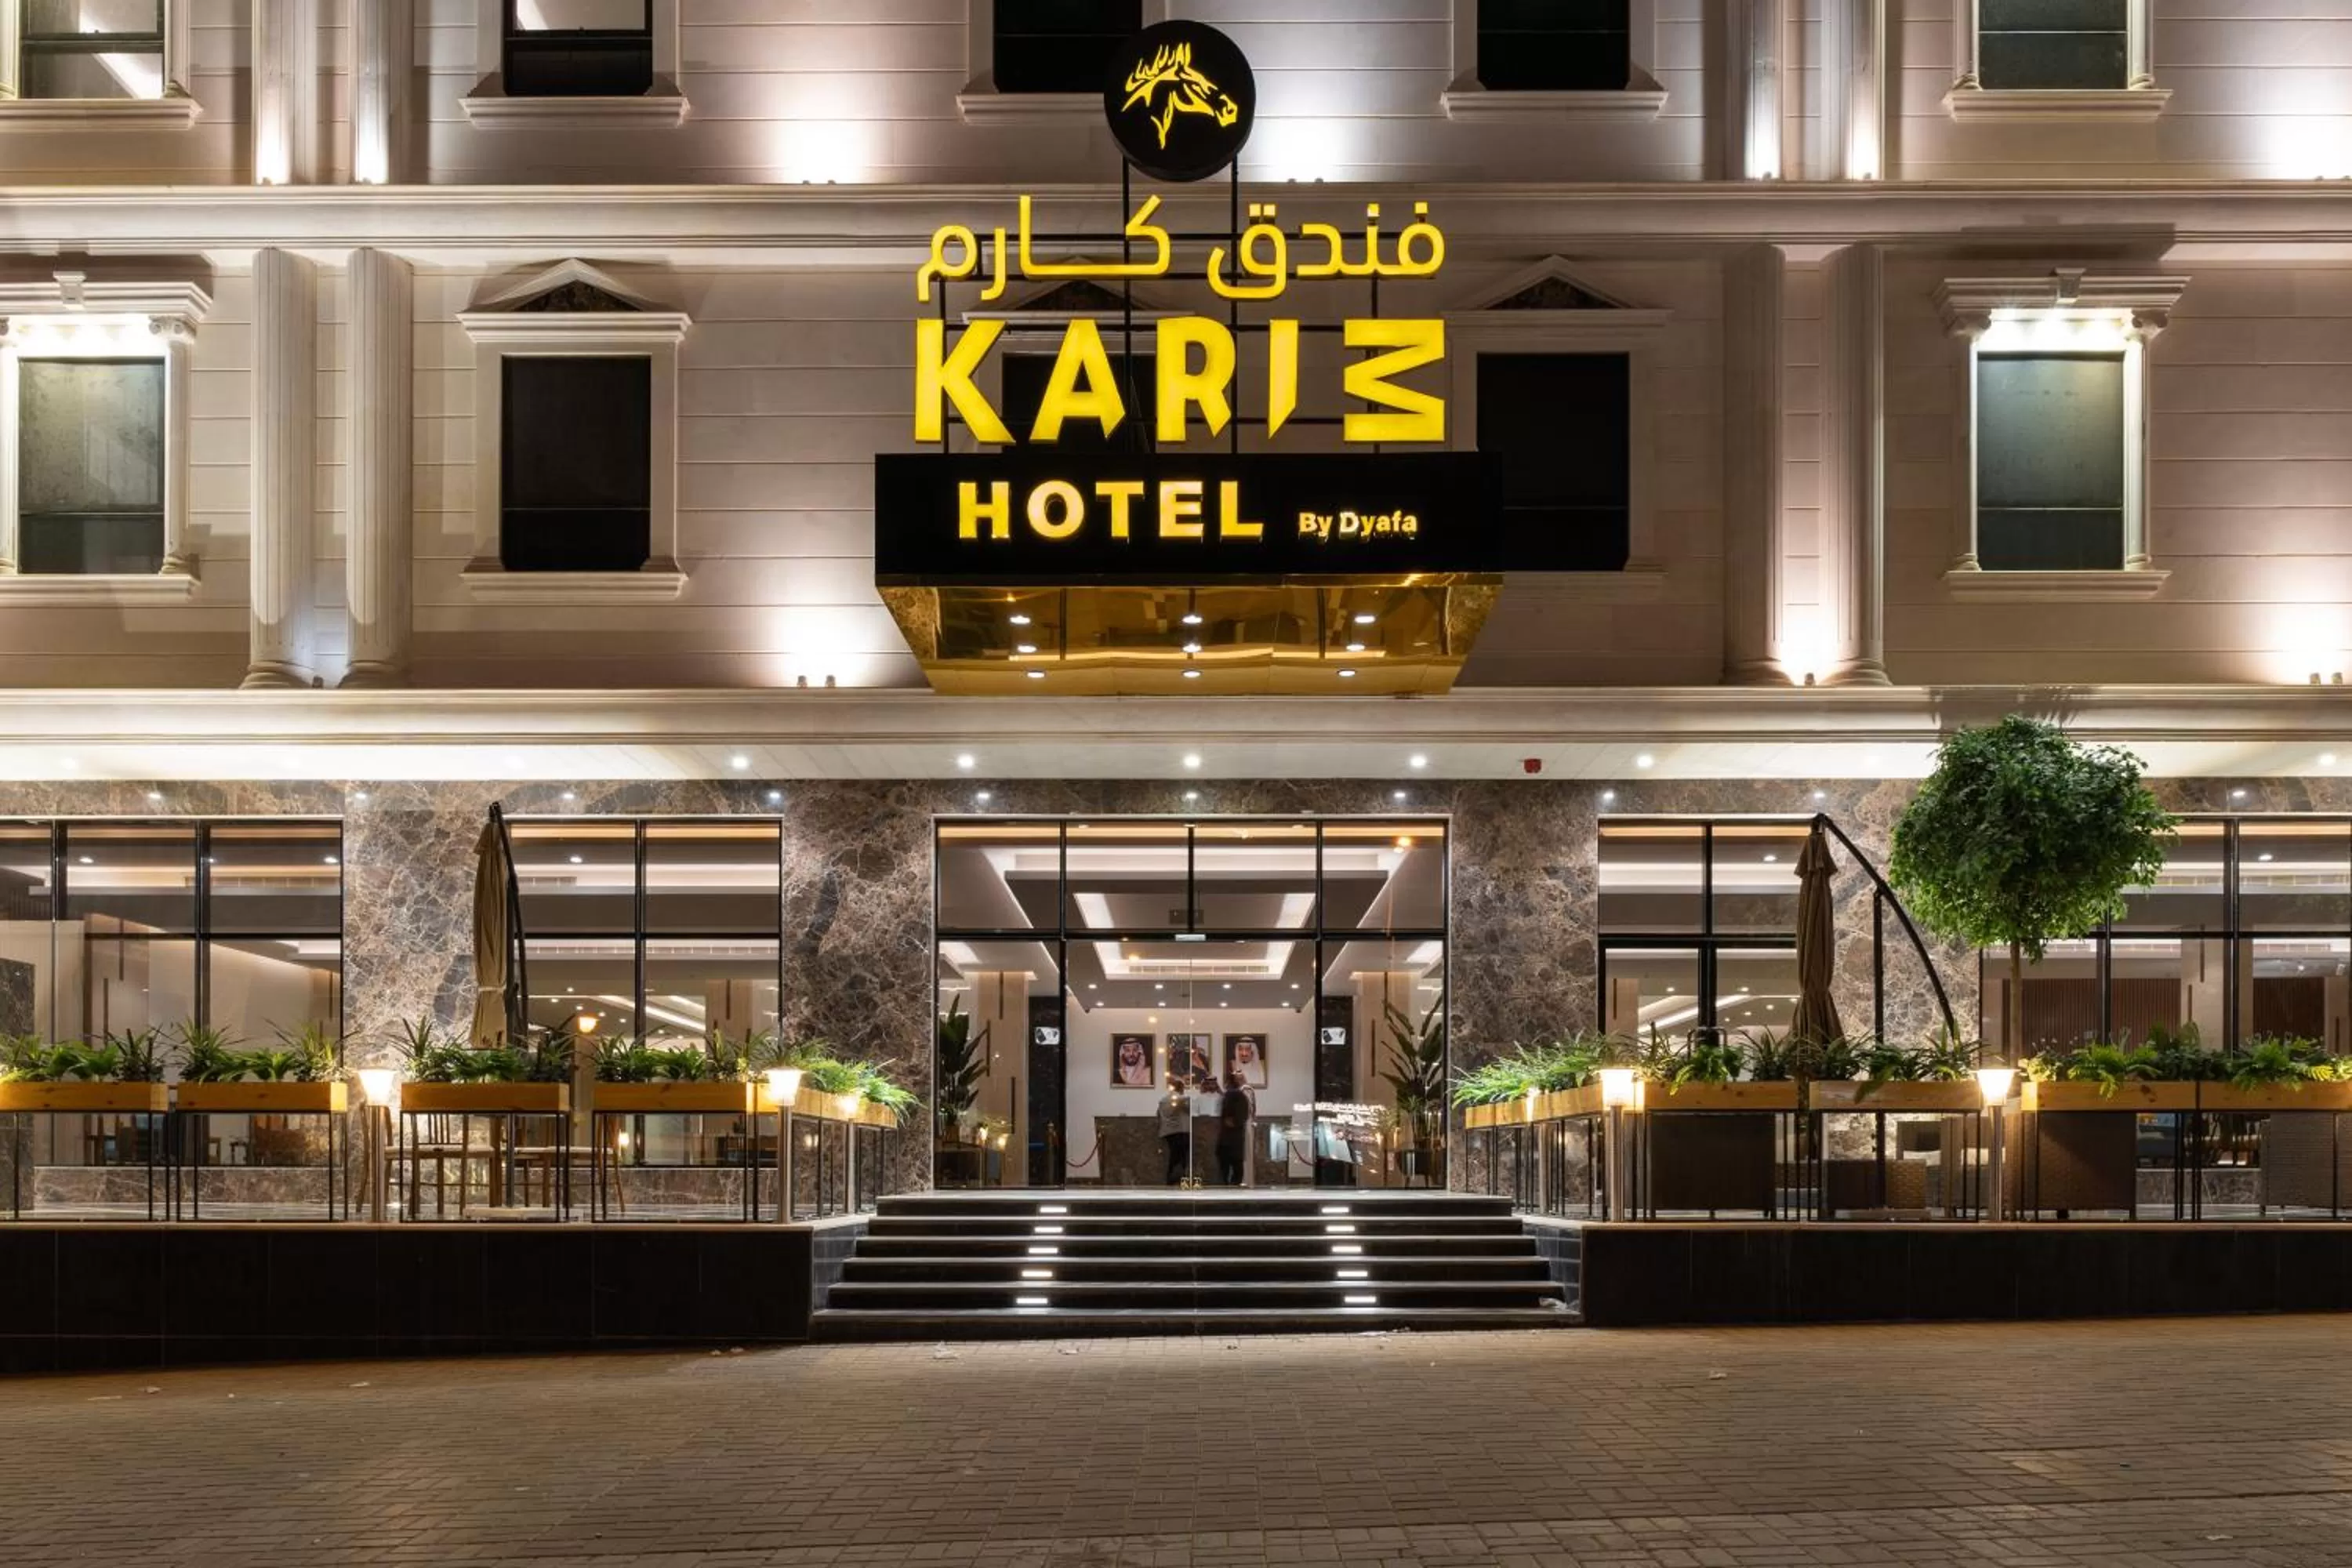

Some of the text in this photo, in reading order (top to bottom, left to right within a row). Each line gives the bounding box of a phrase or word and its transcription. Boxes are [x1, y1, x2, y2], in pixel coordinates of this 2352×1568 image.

[914, 194, 1445, 302] فندق كارم
[960, 481, 1263, 539] HOTEL
[1299, 510, 1417, 538] By Dyafa
